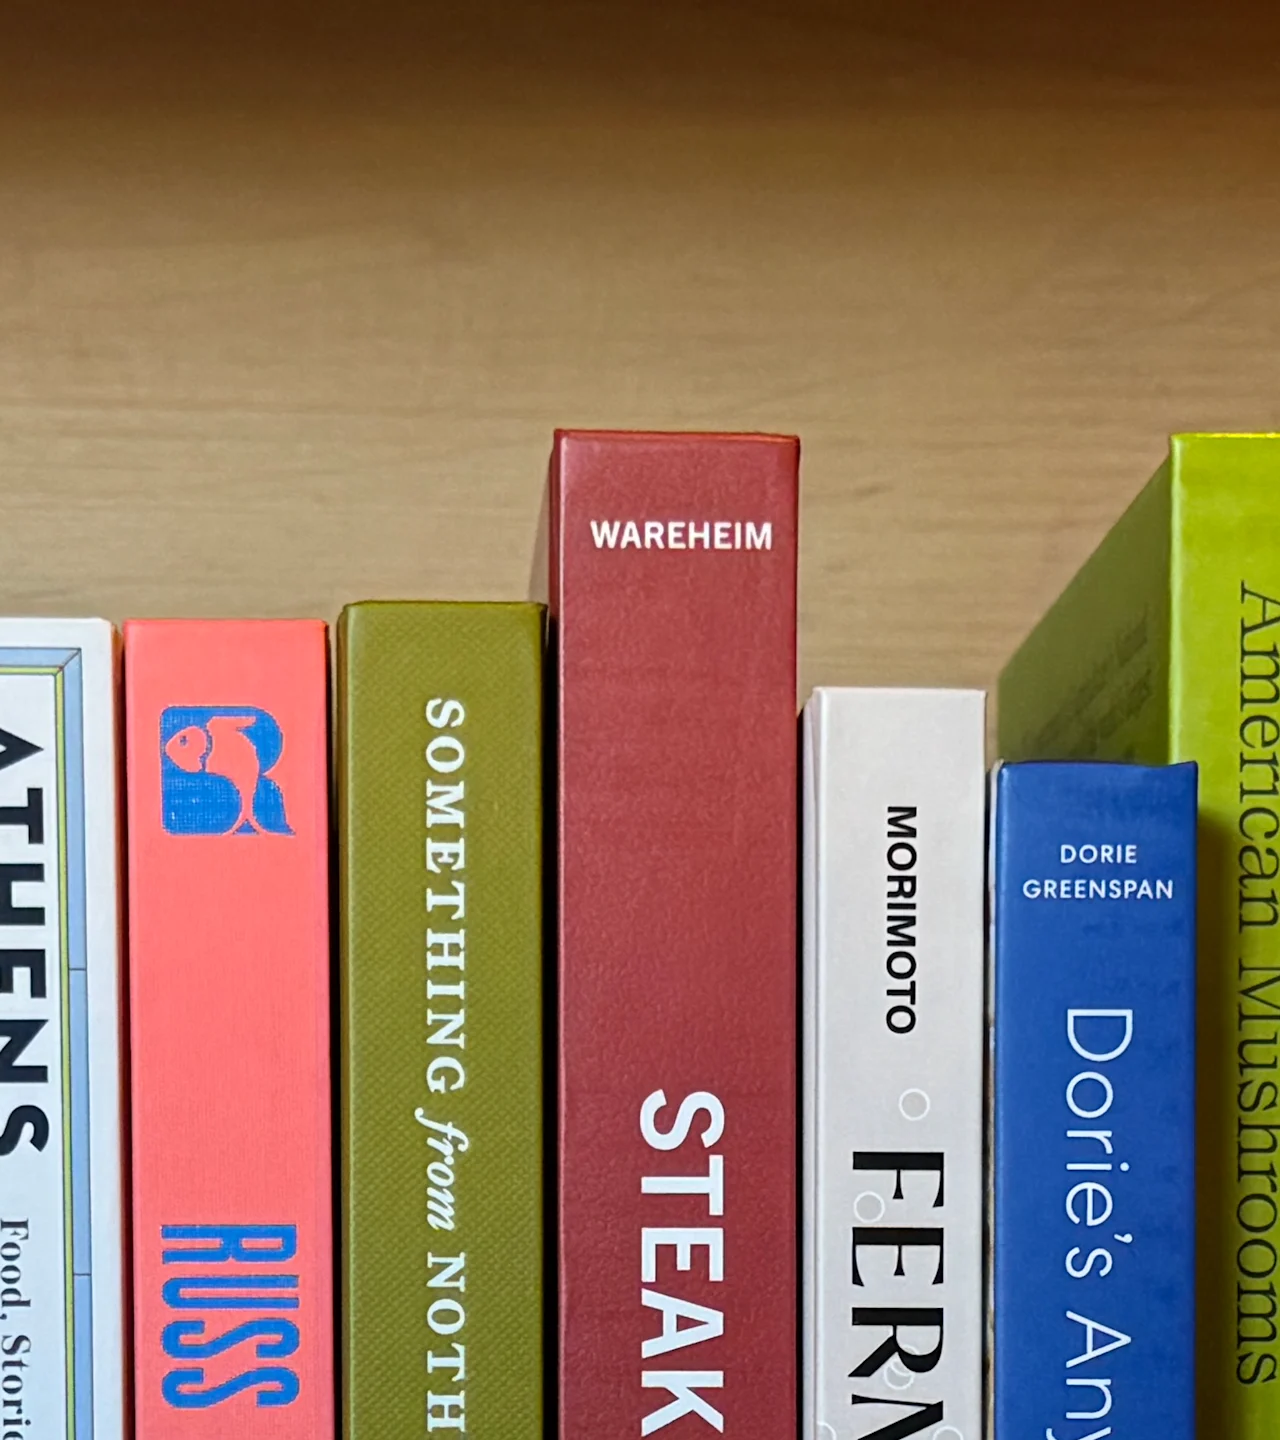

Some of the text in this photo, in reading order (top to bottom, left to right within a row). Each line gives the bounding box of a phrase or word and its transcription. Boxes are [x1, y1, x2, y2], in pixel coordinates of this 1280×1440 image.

[590, 520, 773, 551] WAREHEIM
[424, 697, 466, 1095] SOMETHING
[886, 806, 917, 1035] MORIMOTO
[1022, 879, 1174, 900] GREENSPAN
[1060, 844, 1137, 864] DORIE
[416, 1107, 468, 1232] from
[160, 1222, 300, 1409] RUSS
[640, 1088, 725, 1437] STEAK
